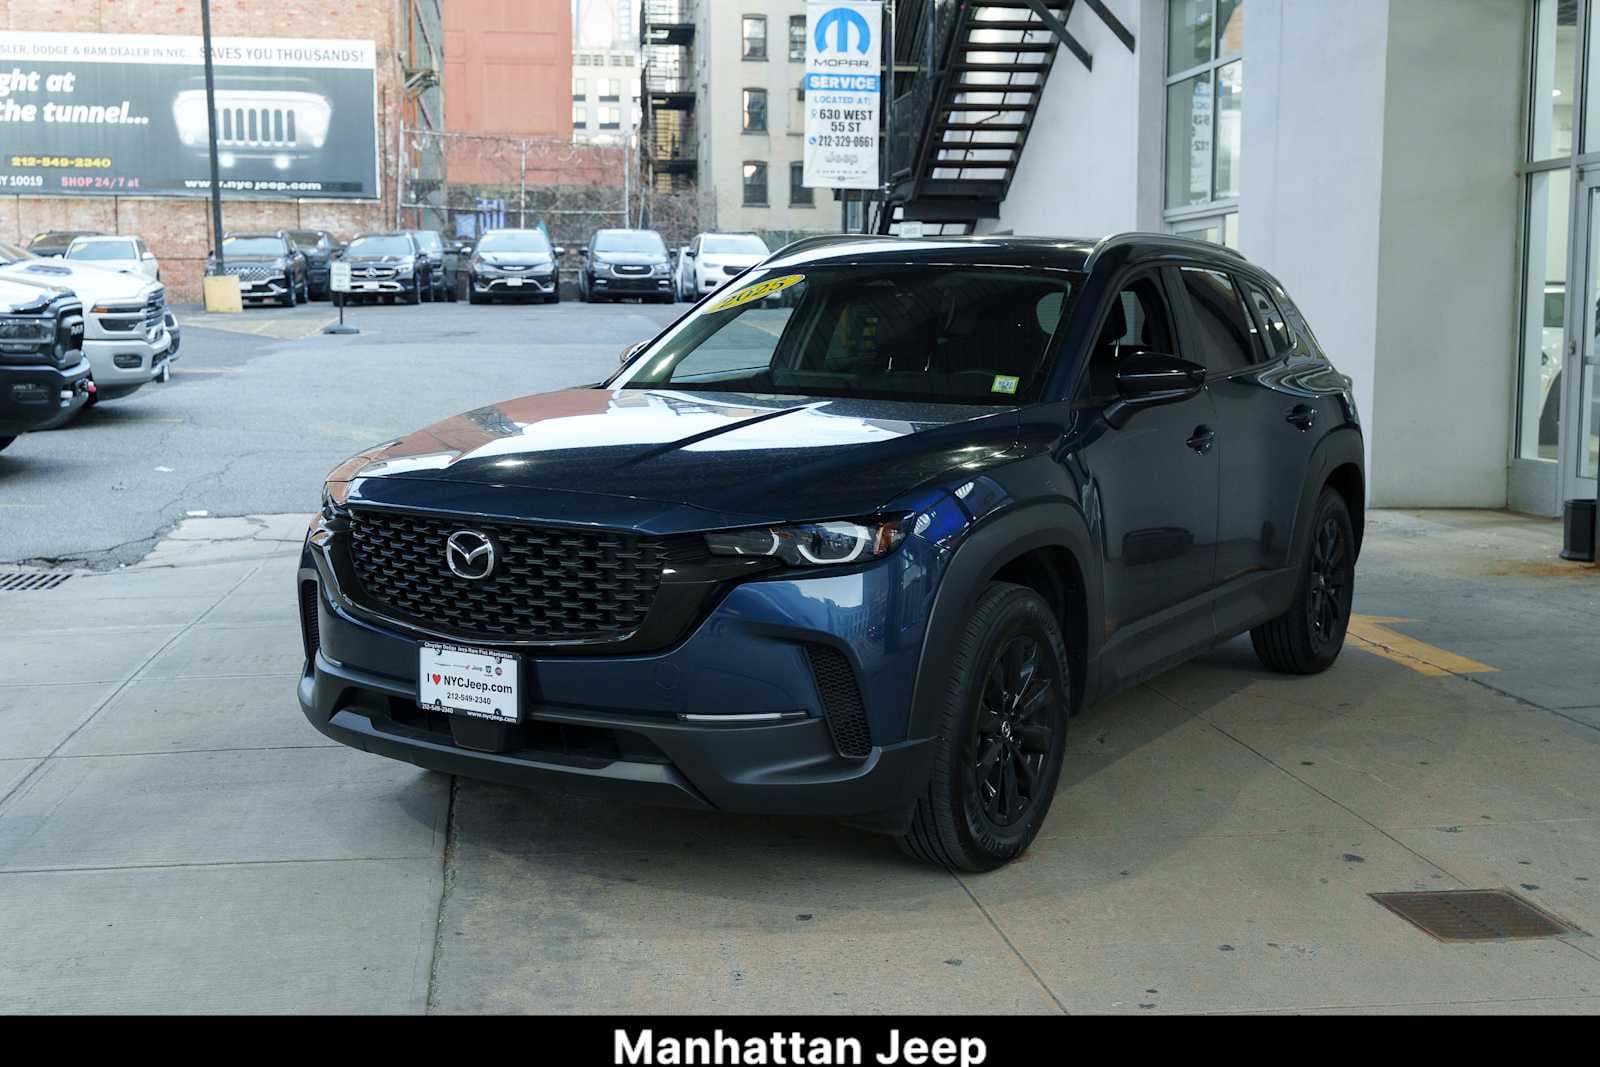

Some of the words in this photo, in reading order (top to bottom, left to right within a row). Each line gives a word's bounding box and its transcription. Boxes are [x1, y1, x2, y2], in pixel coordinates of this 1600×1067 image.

[83, 46, 108, 56] RAM
[110, 47, 150, 57] DEALER
[246, 48, 273, 60] YOU
[276, 49, 364, 63] THOUSANDS!
[814, 59, 870, 67] MOPAR
[45, 72, 76, 92] at
[810, 75, 876, 90] SERVICE
[815, 95, 854, 104] LOCATED
[43, 101, 149, 124] tunnel...
[819, 109, 841, 121] 630
[843, 110, 873, 121] WEST
[831, 122, 844, 132] 55
[848, 122, 861, 132] ST
[9, 175, 44, 187] 10019
[61, 176, 93, 188] SHOP
[95, 178, 125, 189] 24/7
[718, 280, 787, 307] 2025
[443, 674, 513, 694] NYCJeep.com
[447, 691, 492, 705] 212-549-2340
